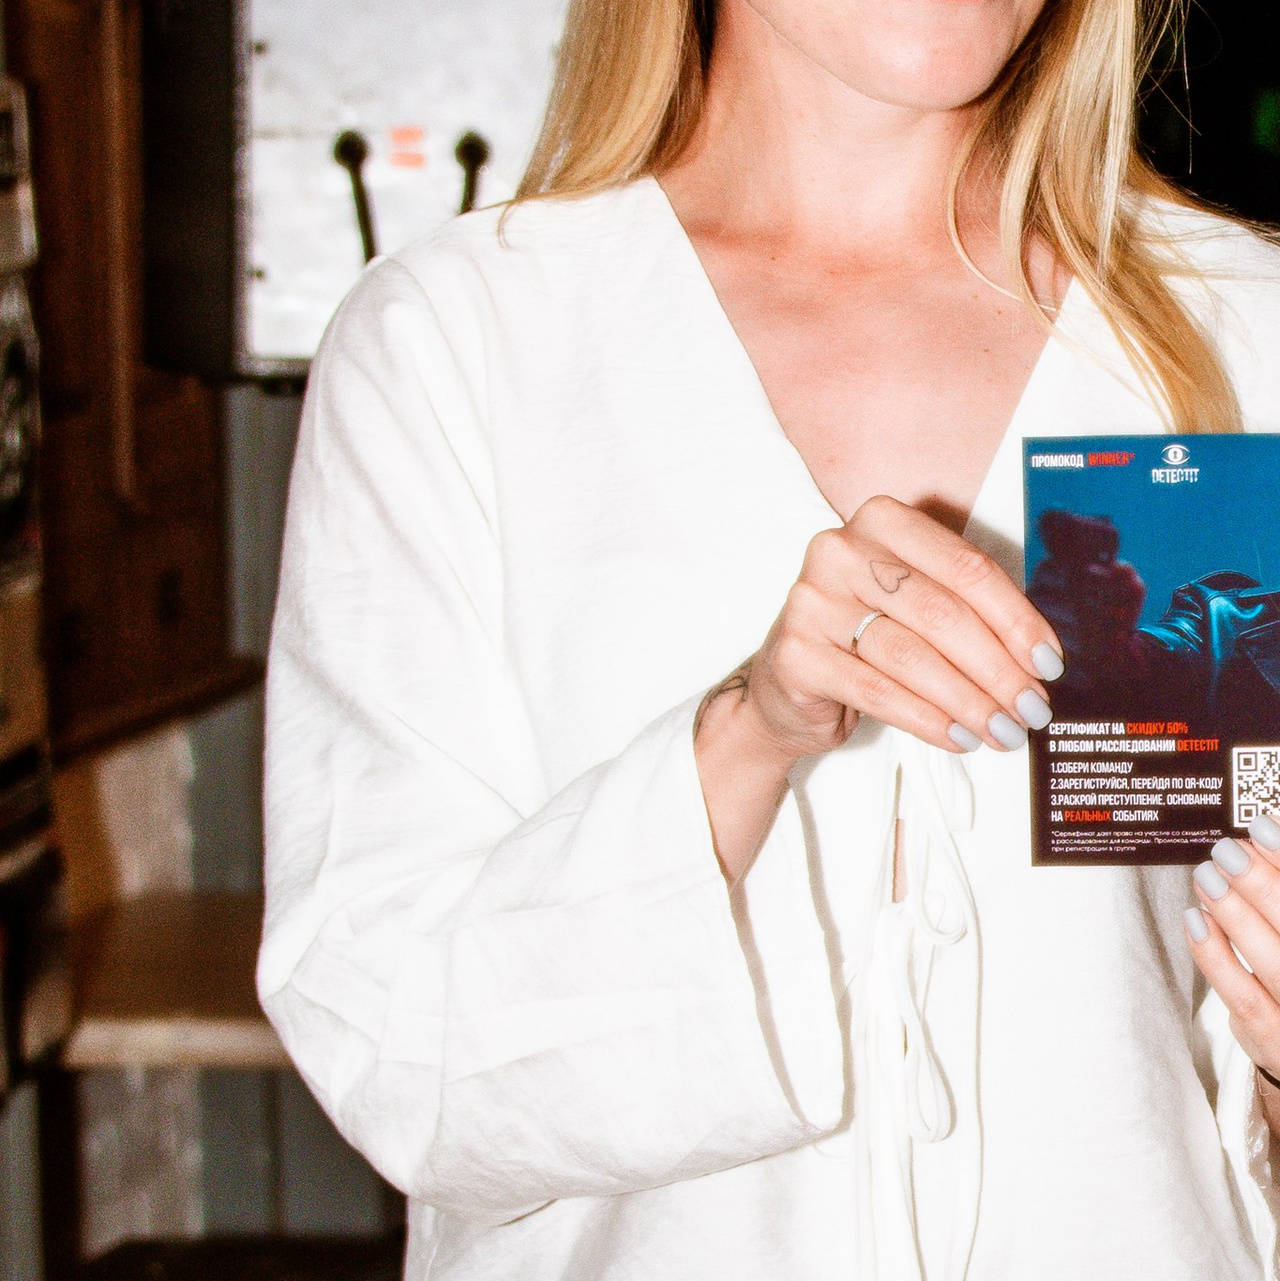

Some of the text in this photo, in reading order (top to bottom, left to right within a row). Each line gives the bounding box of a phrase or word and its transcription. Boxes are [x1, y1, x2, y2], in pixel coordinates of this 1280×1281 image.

[1031, 454, 1084, 468] ПРОМОКОД
[1151, 469, 1199, 483] DETECTIT
[1049, 722, 1188, 736] СЕРТИФИКАТ НА СКИДКУ 50%
[1049, 739, 1219, 754] В ЛЮБОМ РАССЛЕДОВАНИИ DETECTIT
[1051, 762, 1133, 774] 1.СОБЕРИ КОМАНДУ
[1051, 777, 1223, 790] 2.ЗАРЕГИСТРУЙСЯ, ПЕРЕЙДЯ ПО QR-КОДУ
[1051, 793, 1096, 805] 3.РАСКРОЙ
[1167, 794, 1222, 805] ОСНОВАННОЕ
[1051, 810, 1159, 822] НА РЕАЛЬНЫХ СОБЫТИЯХ
